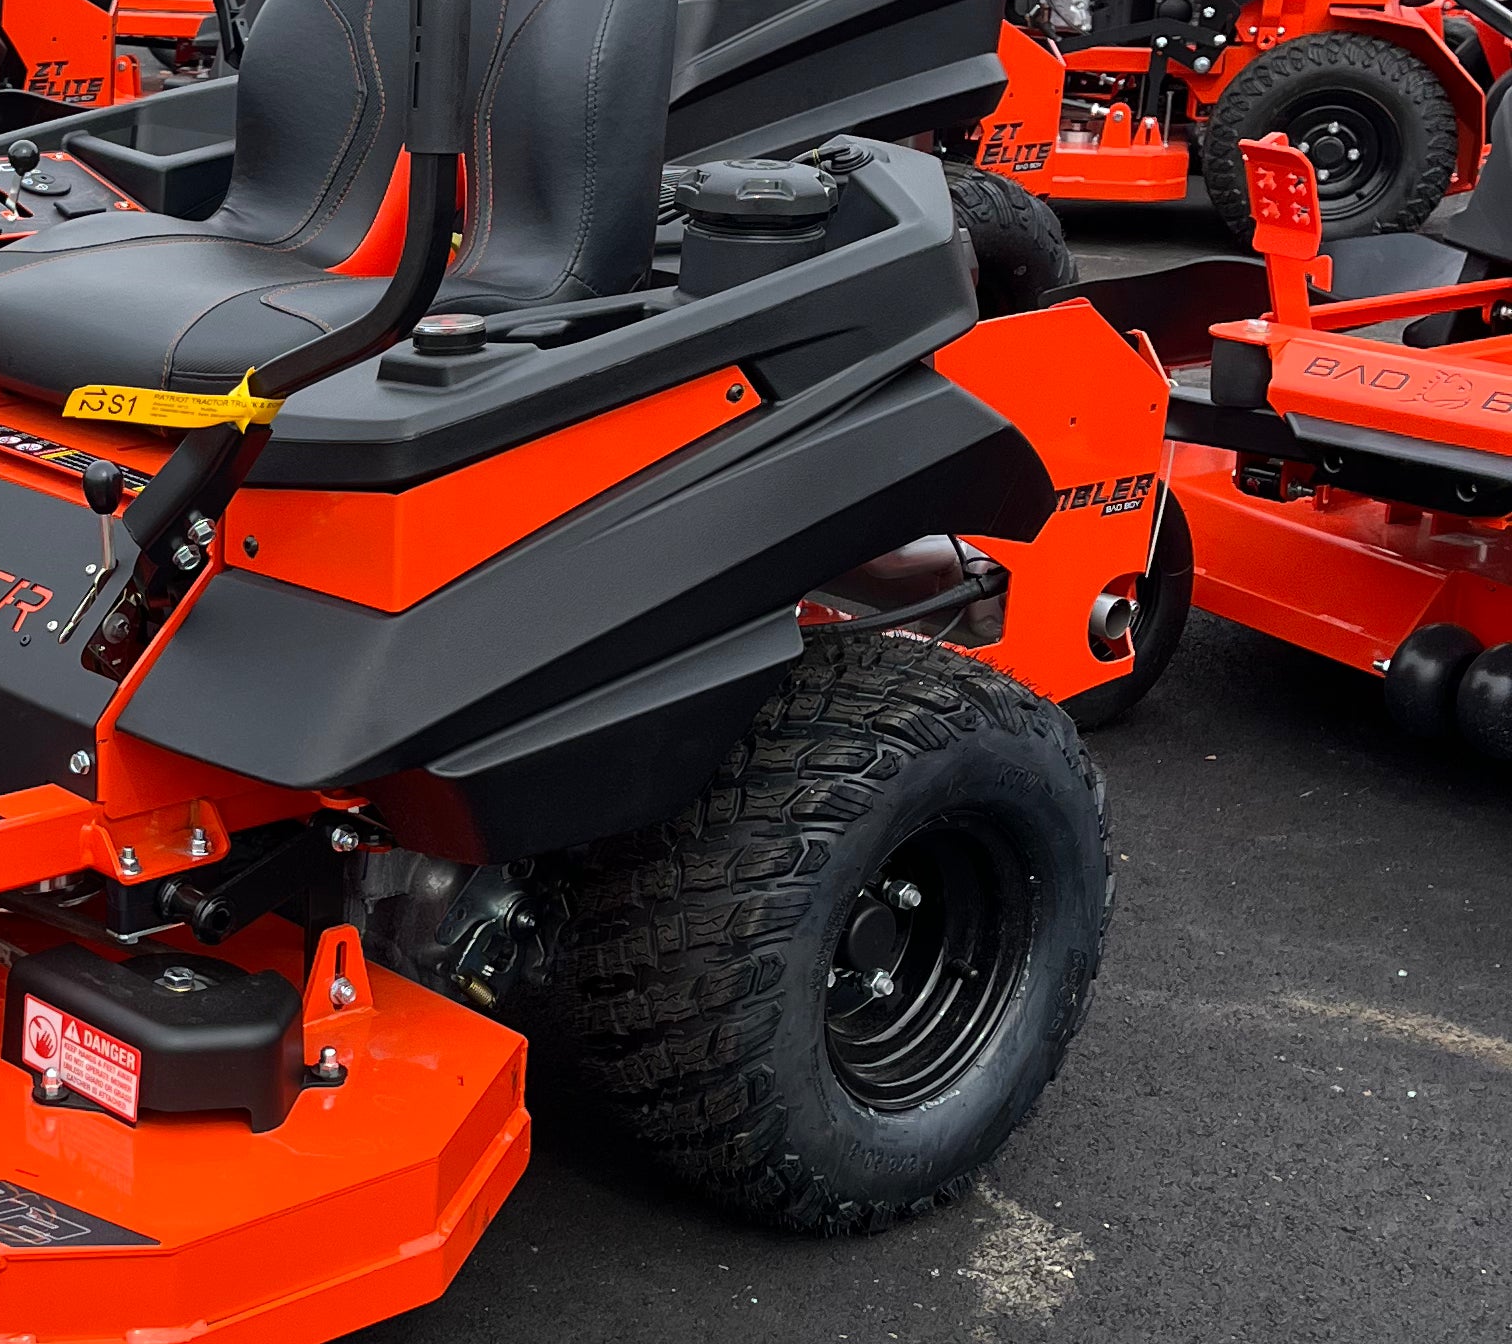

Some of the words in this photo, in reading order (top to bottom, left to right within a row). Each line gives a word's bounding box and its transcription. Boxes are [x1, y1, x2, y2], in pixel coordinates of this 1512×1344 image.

[33, 60, 69, 78] ZT
[28, 77, 105, 97] ELITE
[989, 122, 1024, 142] ZT
[981, 142, 1054, 166] ELITE
[1304, 357, 1411, 391] BAD
[153, 393, 190, 404] PATRIOT
[191, 397, 229, 408] TRACTOR
[1105, 503, 1123, 514] BAD
[1123, 499, 1142, 510] BOY
[83, 1029, 136, 1071] DANGER
